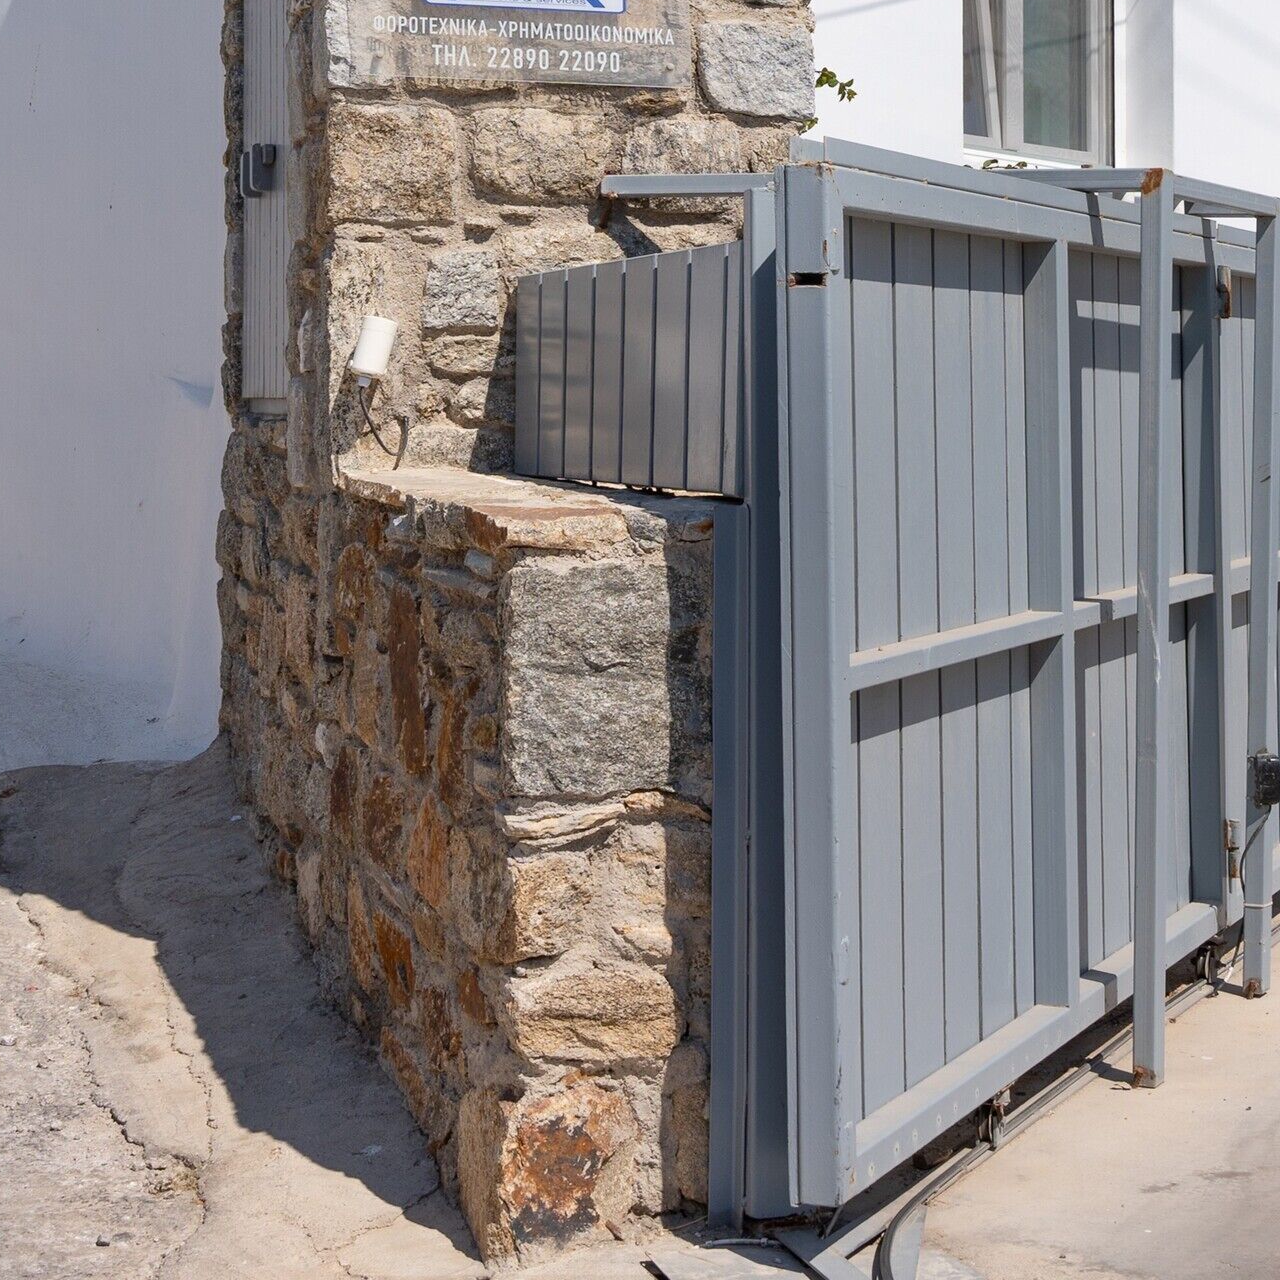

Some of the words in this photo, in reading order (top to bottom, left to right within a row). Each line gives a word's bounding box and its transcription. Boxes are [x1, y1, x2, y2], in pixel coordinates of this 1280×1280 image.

[431, 43, 478, 67] ΤΗΛ.
[487, 46, 549, 70] 22890
[558, 50, 621, 74] 22090
